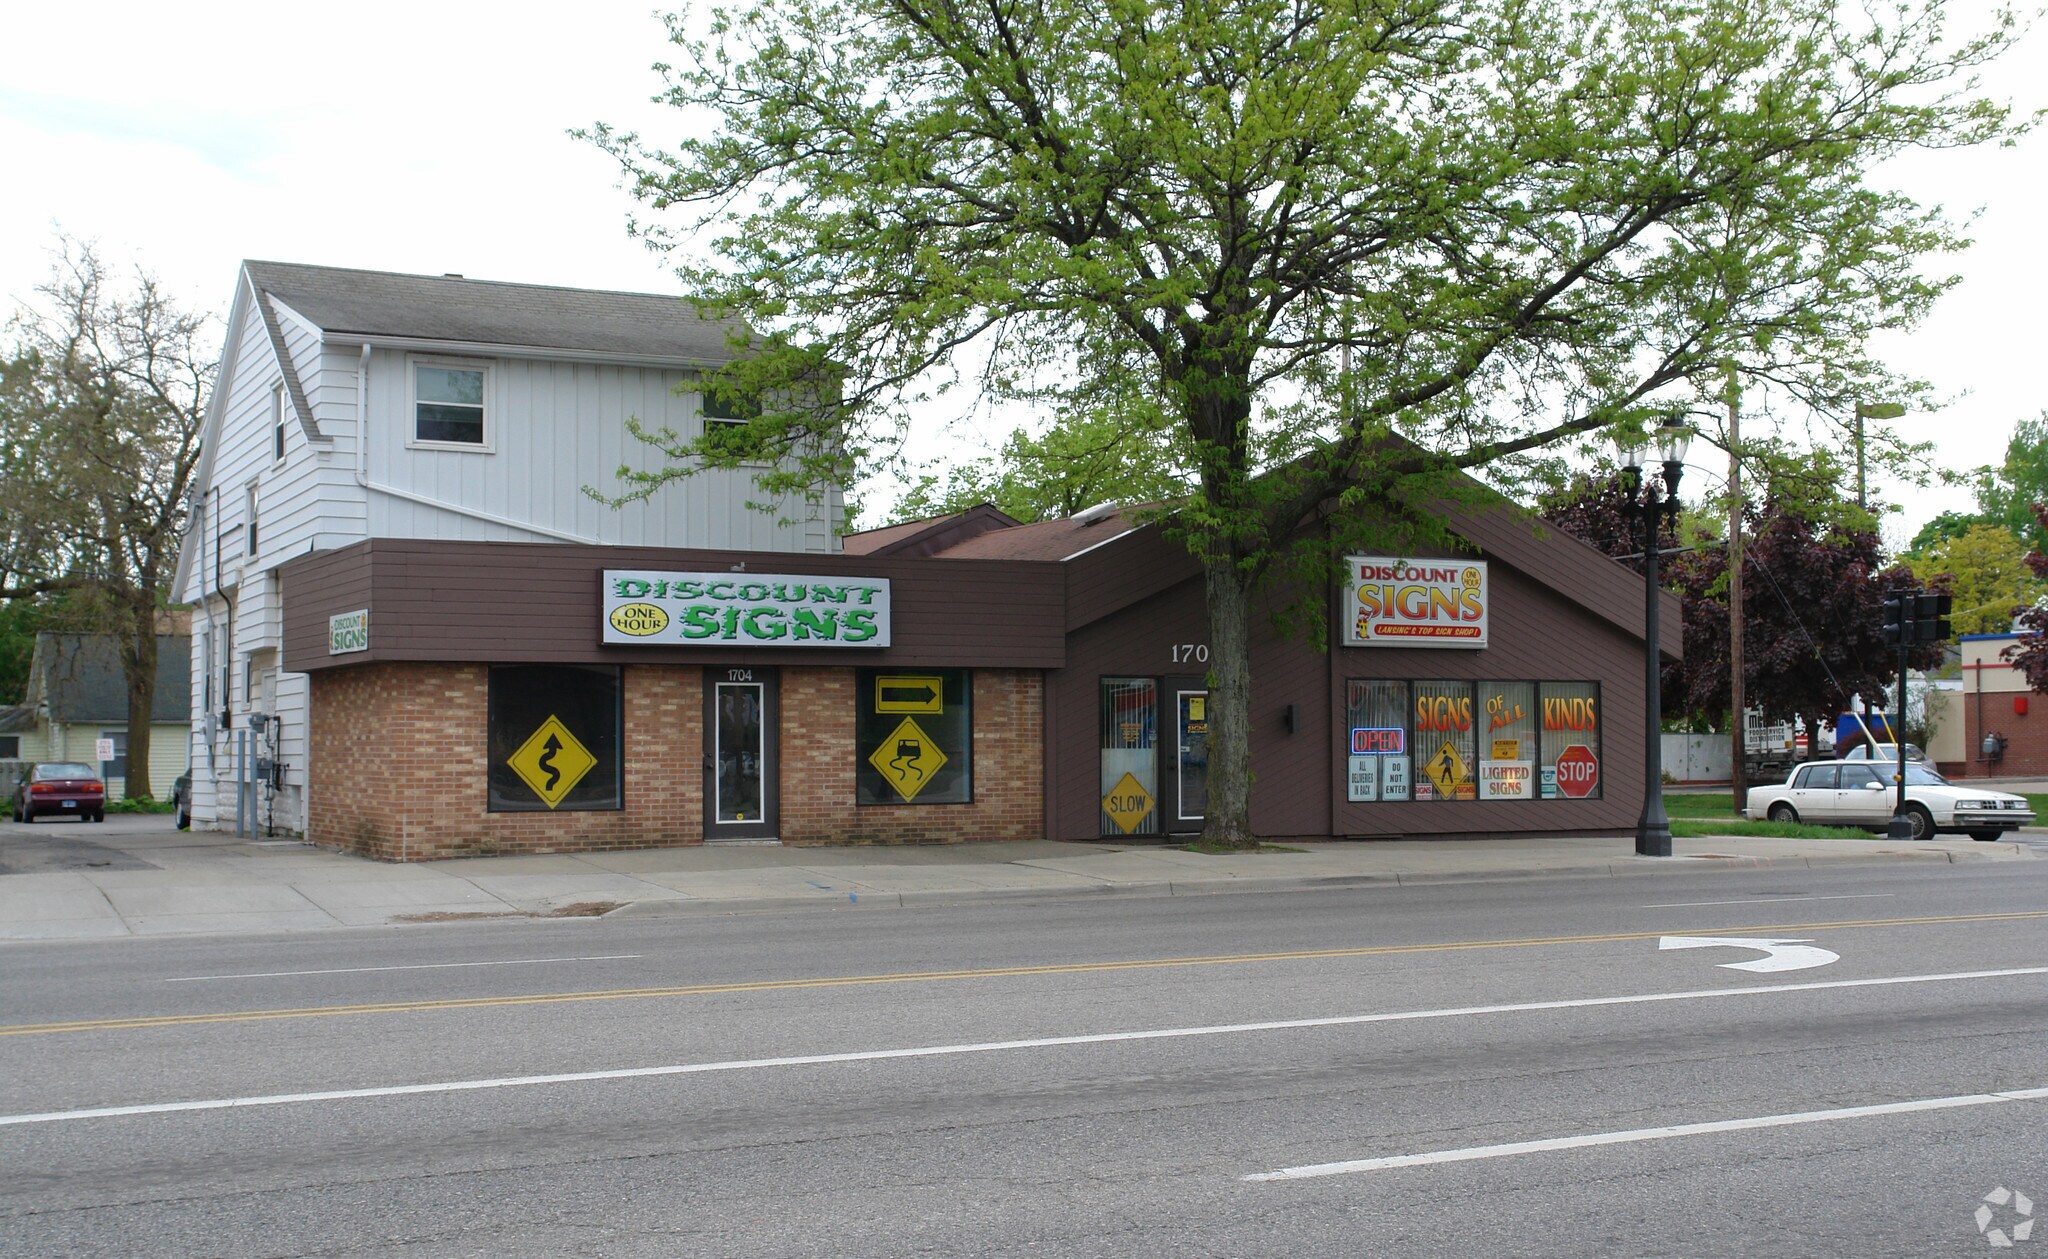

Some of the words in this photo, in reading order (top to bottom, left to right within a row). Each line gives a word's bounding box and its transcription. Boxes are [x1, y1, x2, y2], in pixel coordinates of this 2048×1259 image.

[1361, 565, 1458, 583] DISCOUNT
[613, 578, 882, 604] DISCOUNT
[1357, 584, 1483, 621] SIGNS
[334, 615, 360, 630] DISCOUNT
[624, 607, 656, 620] ONE
[616, 618, 661, 631] HOUR
[680, 605, 878, 642] SIGNS
[1377, 626, 1416, 634] LANSING'S
[1418, 627, 1433, 635] TOP
[1435, 627, 1452, 635] SIGN
[1454, 628, 1478, 636] SHOP!
[334, 628, 366, 650] SIGNS
[1171, 644, 1209, 663] 170
[728, 669, 752, 681] 1704
[1486, 695, 1504, 714] OF
[1417, 696, 1471, 732] SIGNS
[1488, 704, 1527, 734] ALL
[1544, 697, 1596, 731] KINDS
[1354, 731, 1402, 751] OPEN
[1392, 763, 1401, 771] DO
[1482, 767, 1529, 780] LIGHTED
[1559, 762, 1595, 782] STOP
[1390, 774, 1403, 783] NOT
[1386, 785, 1407, 794] ENTER
[1489, 782, 1522, 795] SIGNS
[1110, 795, 1146, 813] SLOW
